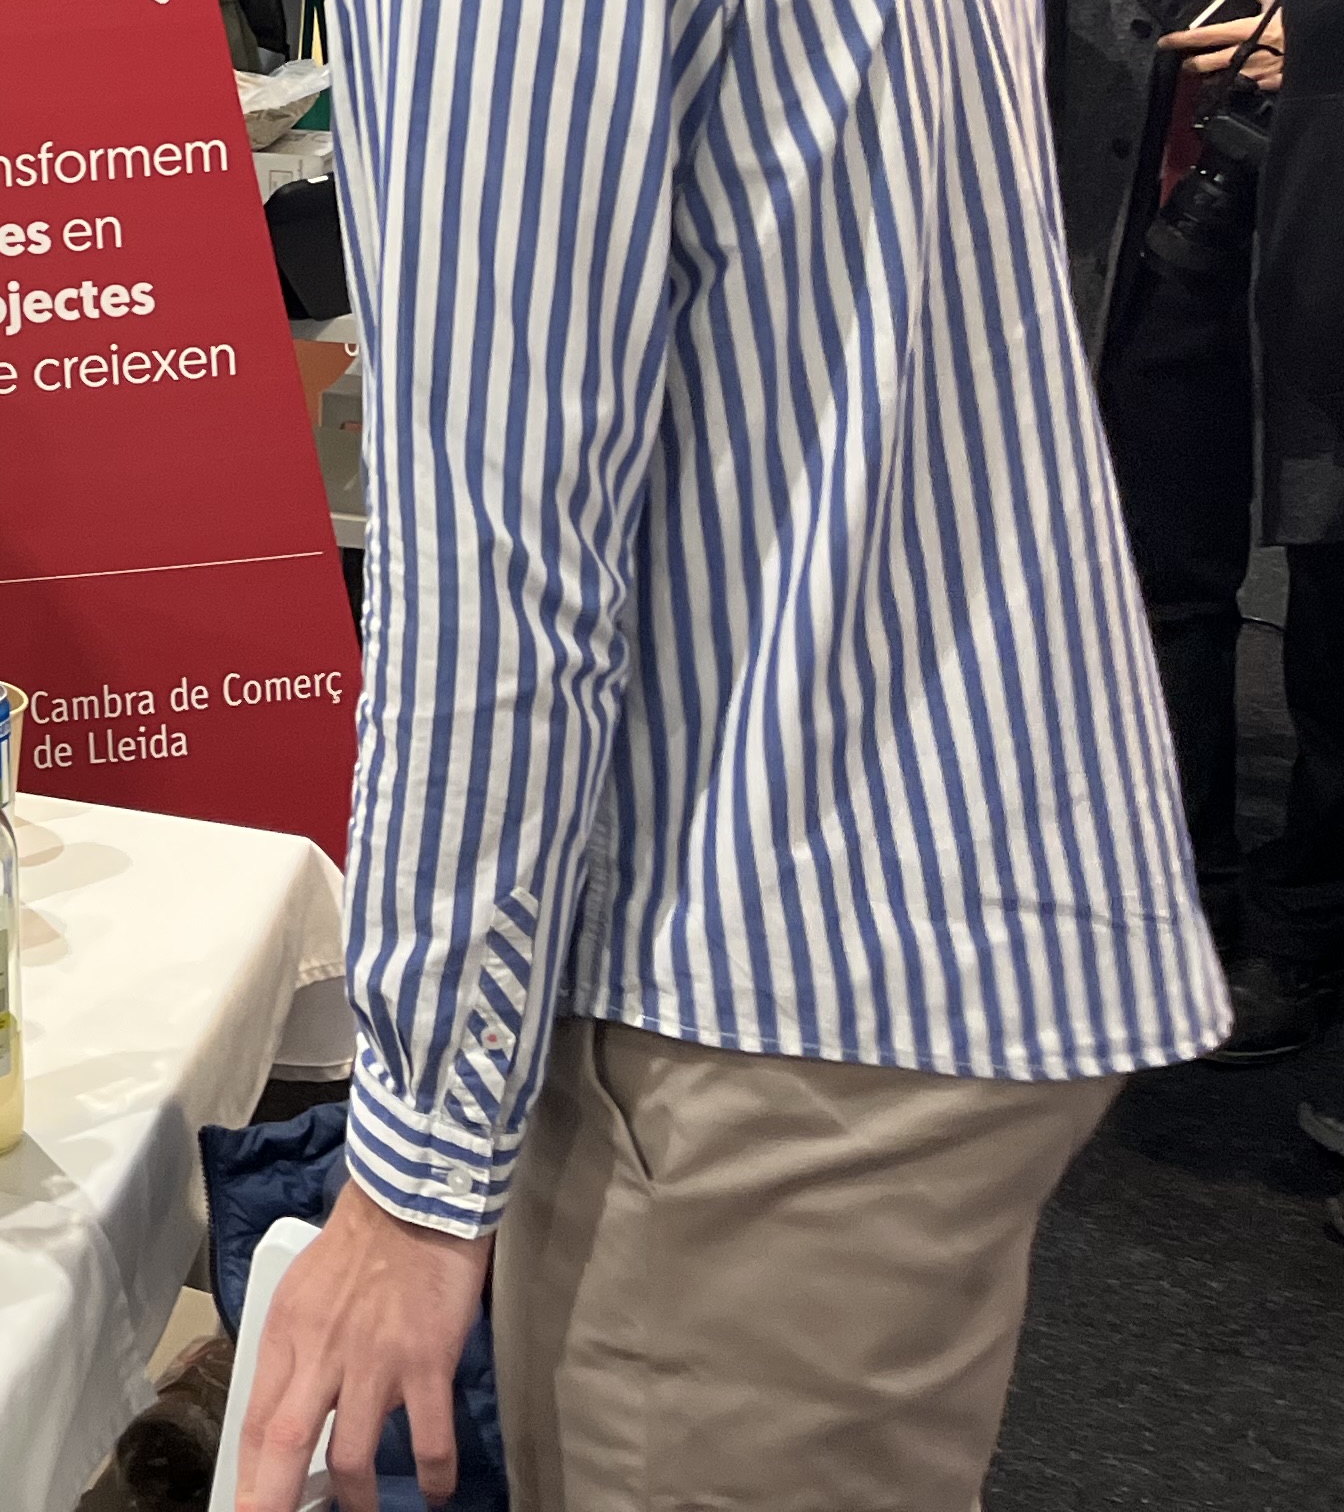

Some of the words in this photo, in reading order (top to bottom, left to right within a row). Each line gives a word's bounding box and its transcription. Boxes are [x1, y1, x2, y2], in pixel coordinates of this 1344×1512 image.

[63, 216, 123, 252] en
[33, 343, 237, 391] creiexen
[30, 684, 156, 724] Cambra
[170, 677, 209, 712] de
[223, 671, 342, 707] Comerç
[33, 734, 73, 769] de
[88, 723, 188, 764] Lleida
